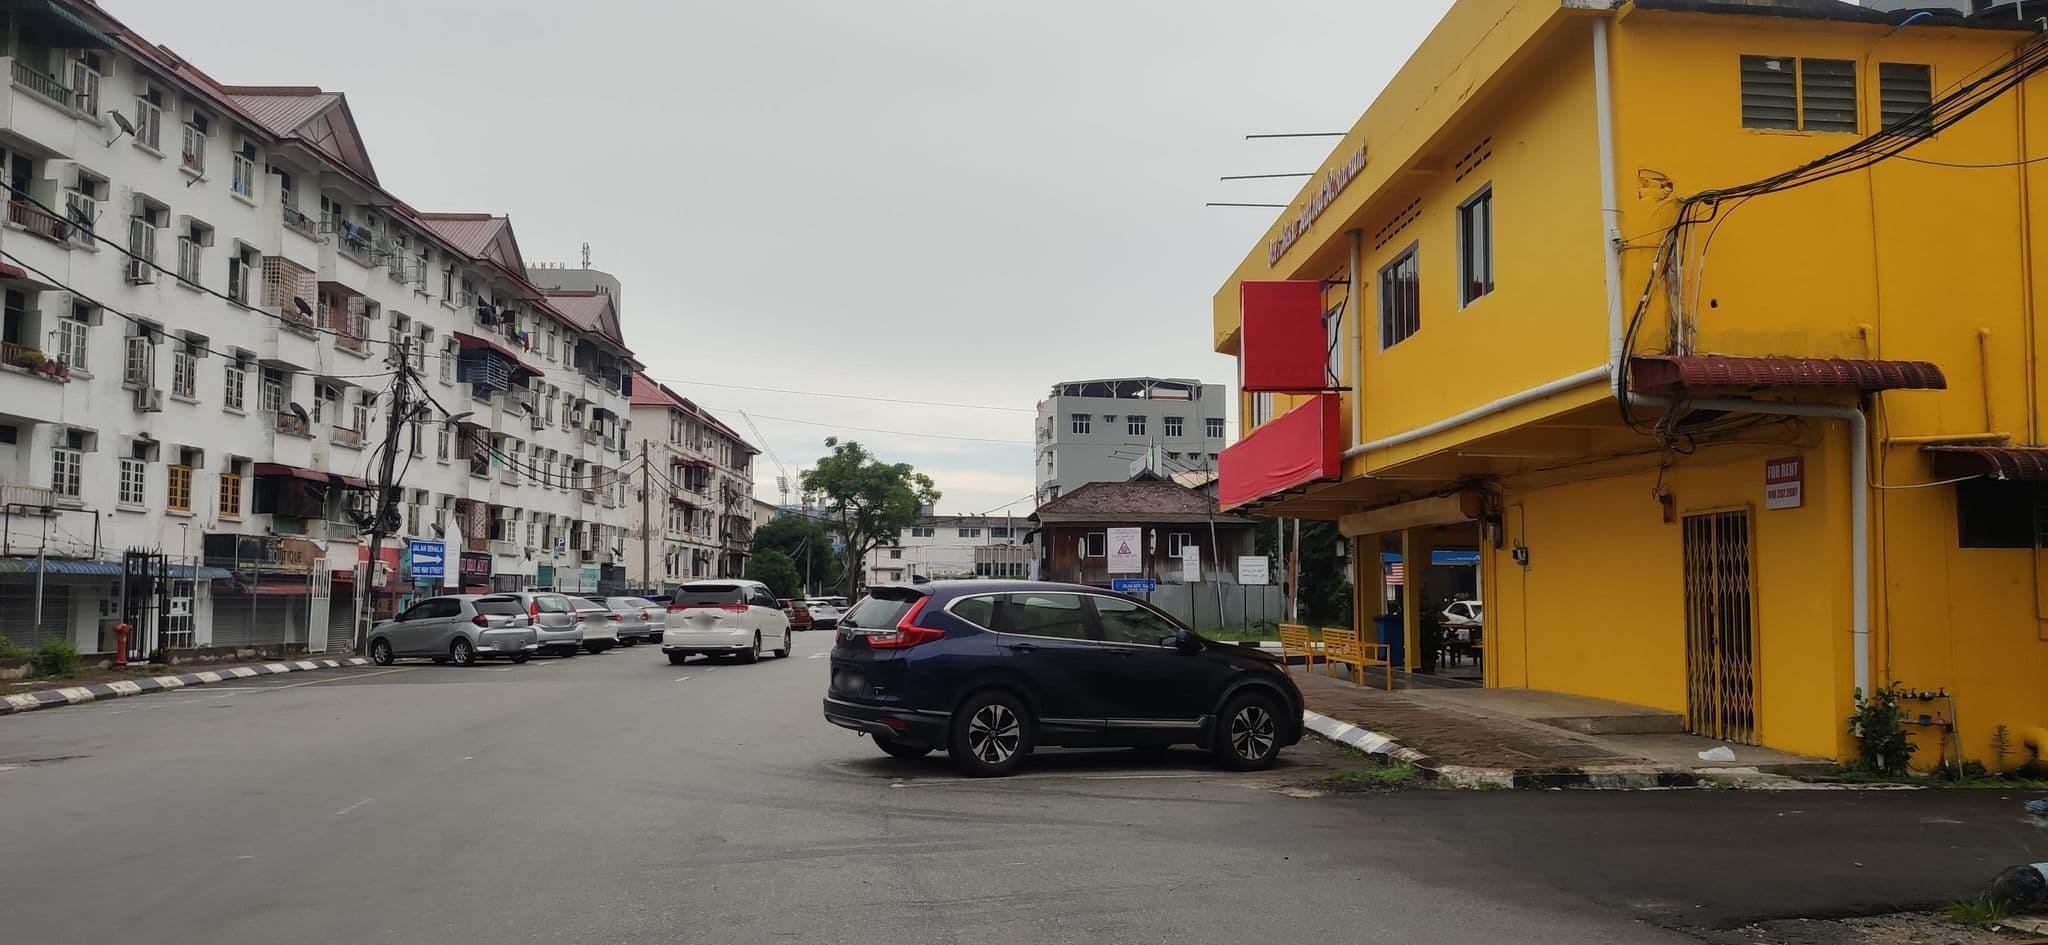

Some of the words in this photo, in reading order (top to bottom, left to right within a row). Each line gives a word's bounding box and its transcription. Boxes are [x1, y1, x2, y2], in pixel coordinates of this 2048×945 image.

[1768, 464, 1780, 480] FOR
[1781, 463, 1799, 478] RENT
[412, 544, 427, 552] JALAN
[269, 550, 302, 563] BOUTIQUE
[412, 566, 420, 574] ONE
